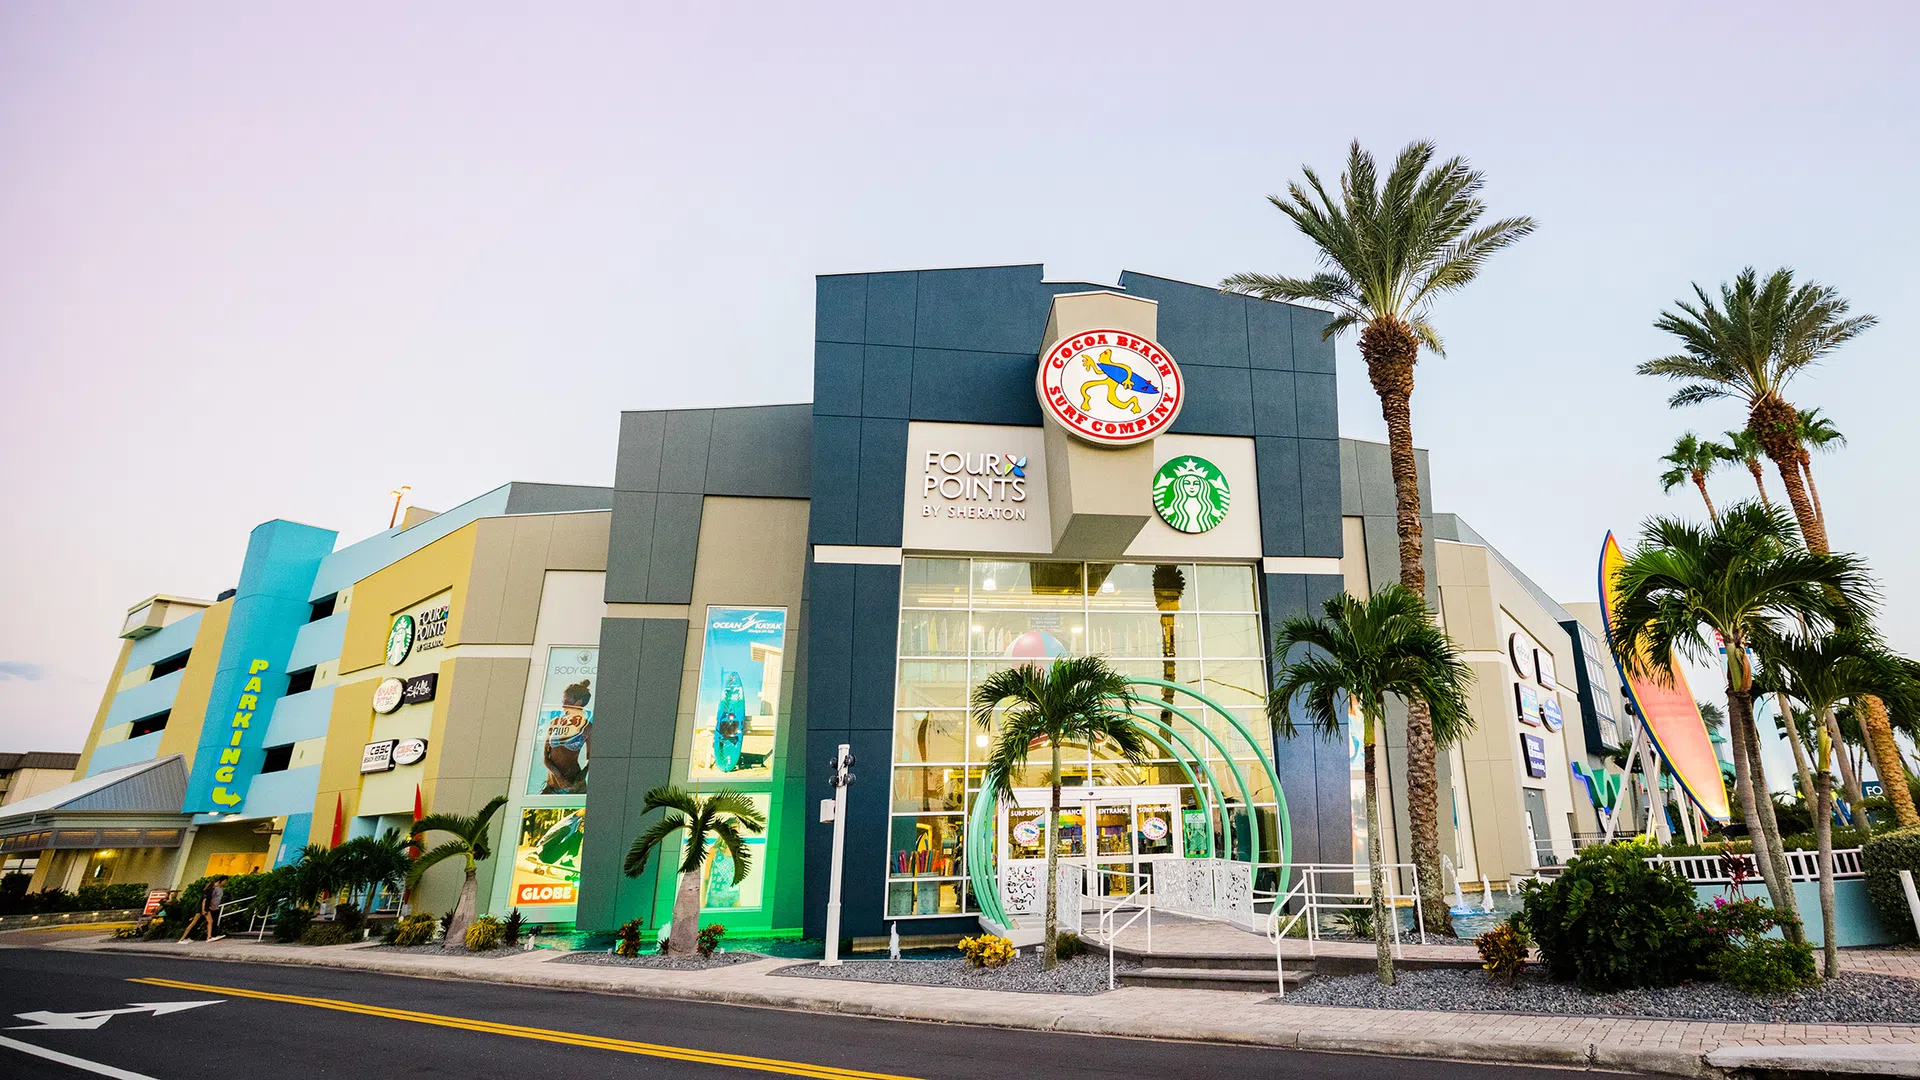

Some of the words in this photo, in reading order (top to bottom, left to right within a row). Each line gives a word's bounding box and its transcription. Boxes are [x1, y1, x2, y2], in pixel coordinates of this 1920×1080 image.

[1052, 334, 1109, 369] COCOA
[1116, 335, 1172, 377] BEACH
[1049, 385, 1088, 425] SURF
[1091, 392, 1174, 434] COMPANY
[925, 450, 1002, 476] FOUR
[923, 475, 1026, 502] POINTS
[922, 504, 941, 518] BY
[948, 505, 1026, 520] SHERATON
[419, 607, 442, 625] FOUR
[712, 621, 743, 629] OCEAN
[416, 619, 448, 641] POINTS
[554, 666, 580, 675] BODY
[214, 659, 269, 783] PARKING
[521, 886, 573, 900] GLOBE
